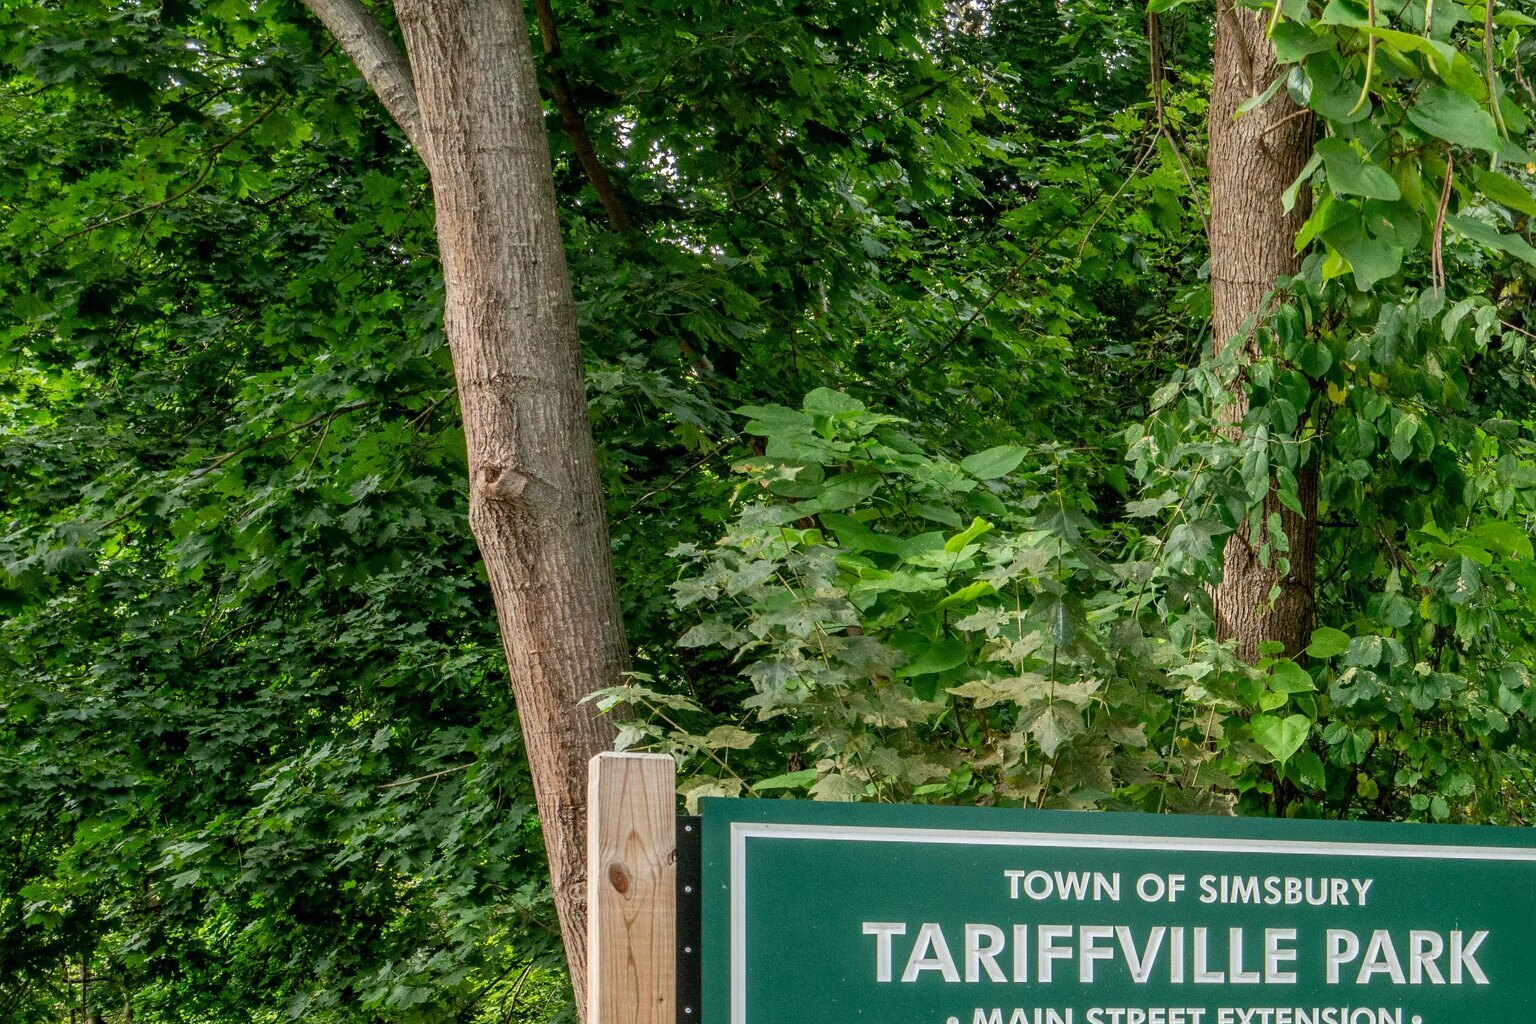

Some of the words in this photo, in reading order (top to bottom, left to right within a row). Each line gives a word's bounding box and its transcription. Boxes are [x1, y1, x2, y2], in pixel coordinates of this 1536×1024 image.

[1003, 869, 1121, 902] TOWN
[1135, 872, 1186, 903] OF
[1198, 874, 1374, 906] SIMSBURY
[861, 921, 1297, 984] TARIFFVILLE
[1326, 928, 1490, 985] PARK
